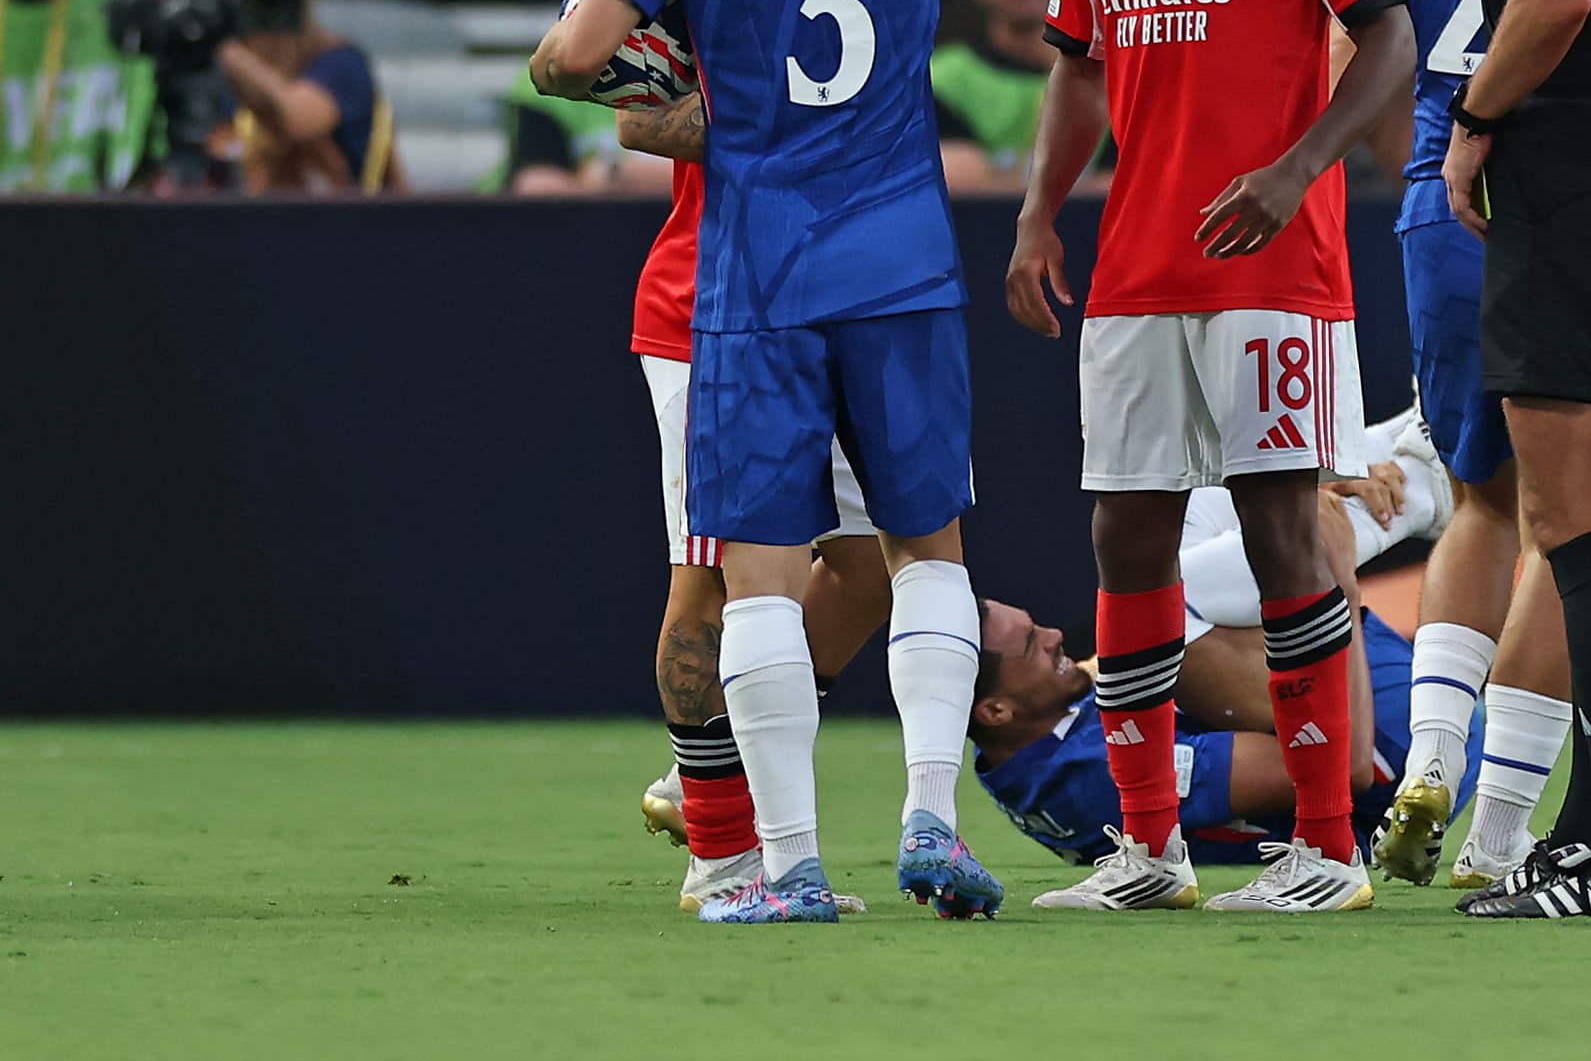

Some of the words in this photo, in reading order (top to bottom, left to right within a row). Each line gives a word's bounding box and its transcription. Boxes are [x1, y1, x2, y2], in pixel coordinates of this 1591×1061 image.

[1116, 13, 1138, 48] FLY
[1141, 10, 1208, 46] BETTER
[1244, 336, 1313, 413] 18
